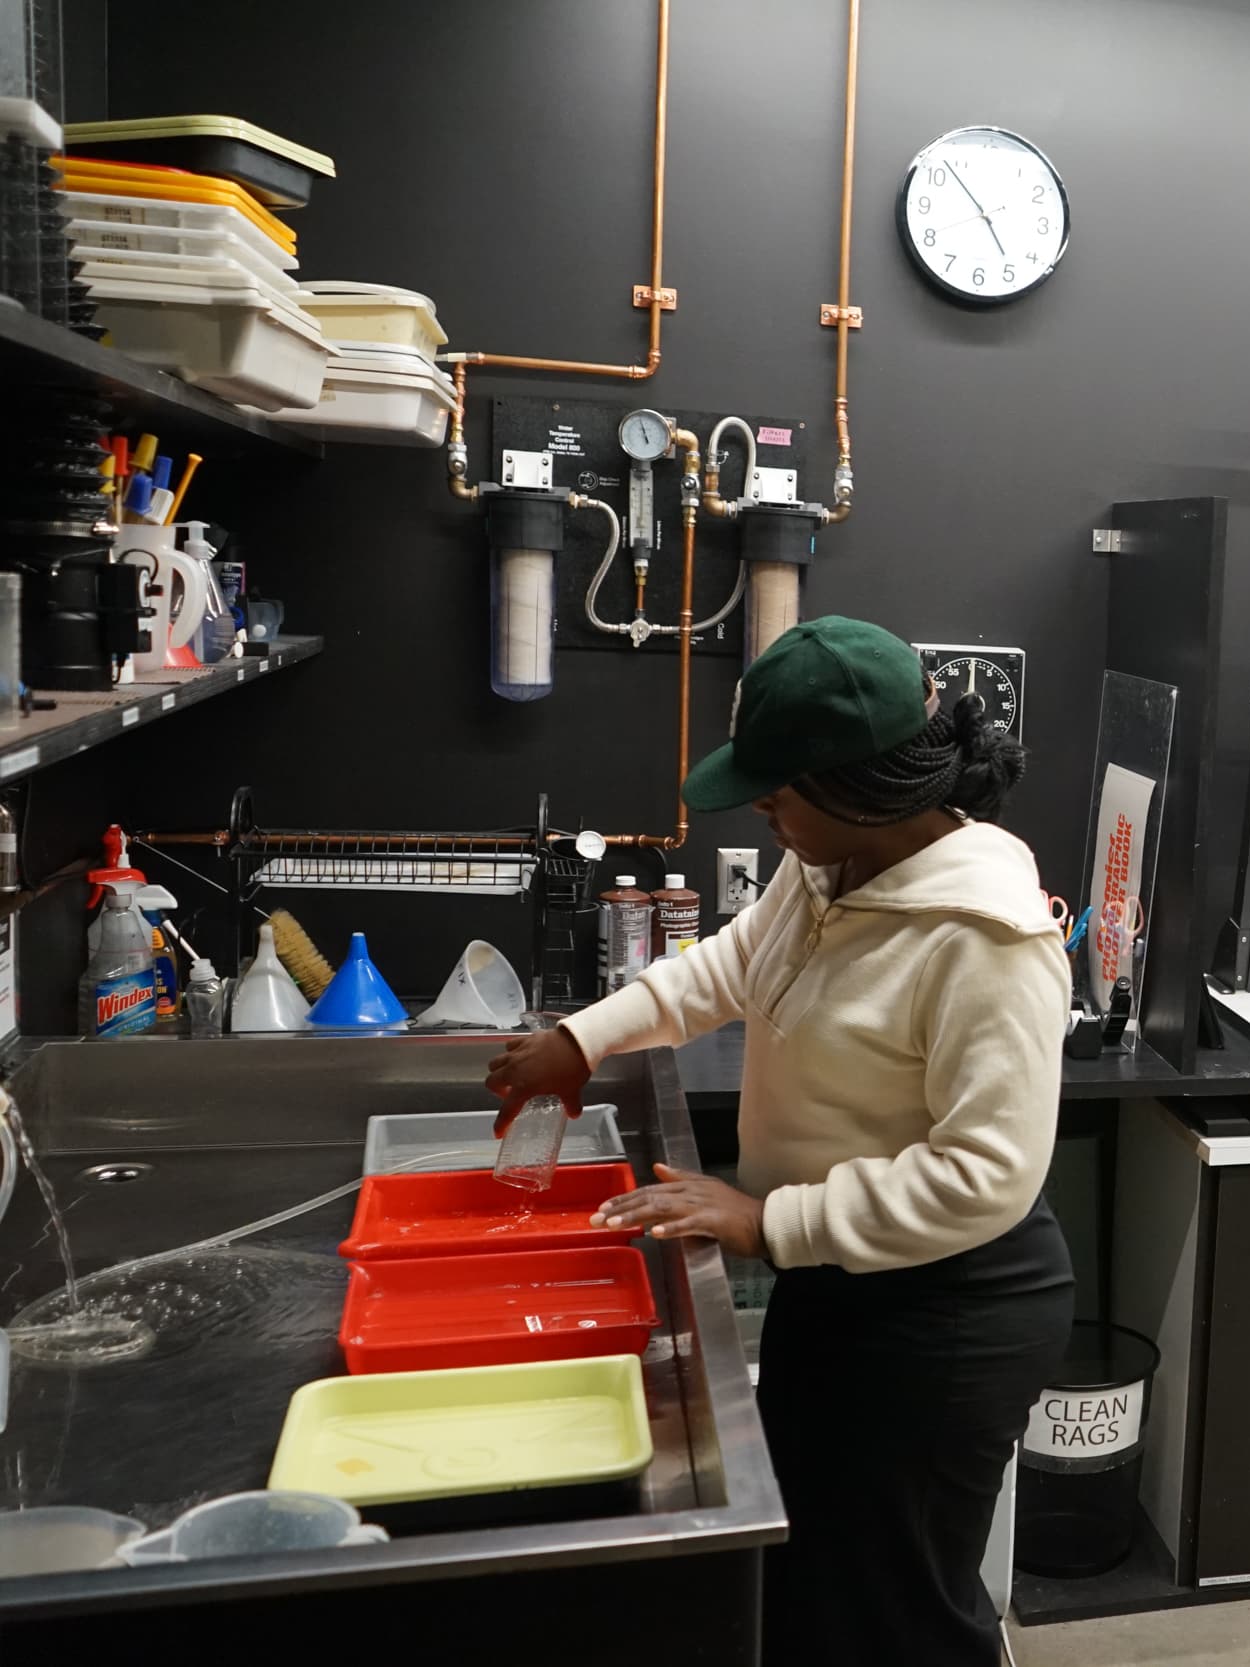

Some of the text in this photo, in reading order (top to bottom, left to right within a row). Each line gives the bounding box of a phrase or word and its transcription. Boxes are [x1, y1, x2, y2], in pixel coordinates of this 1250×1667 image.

[927, 166, 947, 188] 10
[1031, 185, 1046, 205] 2
[918, 195, 932, 216] 9
[1036, 216, 1050, 236] 3
[923, 228, 937, 248] 8
[943, 252, 957, 273] 7
[1025, 250, 1039, 265] 4
[972, 267, 986, 287] 6
[1002, 263, 1016, 283] 5
[548, 442, 568, 451] Model
[717, 623, 725, 640] Cold
[936, 681, 946, 689] 50
[1002, 702, 1010, 710] 15
[994, 720, 1004, 728] 20
[1119, 821, 1132, 882] BOOK
[97, 986, 153, 1027] Windex
[1044, 1393, 1128, 1422] CLEAN
[1051, 1420, 1120, 1447] RAGS
